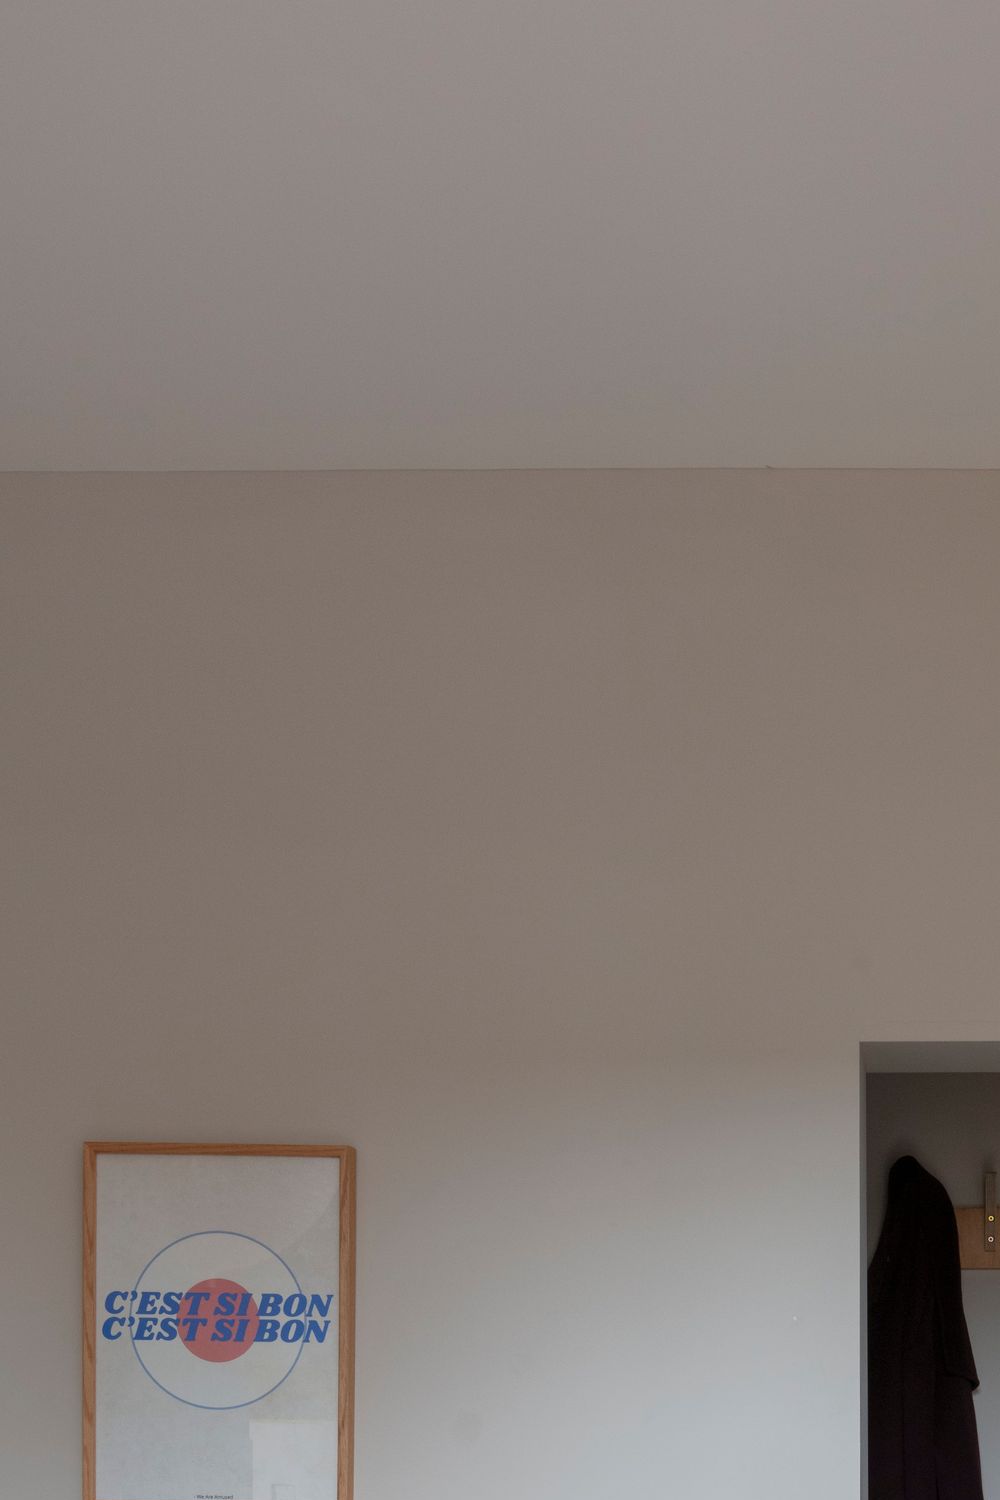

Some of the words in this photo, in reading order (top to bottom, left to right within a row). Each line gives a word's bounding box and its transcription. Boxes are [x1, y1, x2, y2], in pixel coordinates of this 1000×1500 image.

[104, 1290, 210, 1315] C'EST
[213, 1292, 253, 1317] SI
[256, 1293, 334, 1318] BON
[101, 1316, 207, 1341] C'EST
[210, 1318, 250, 1343] SI
[253, 1319, 331, 1344] BON
